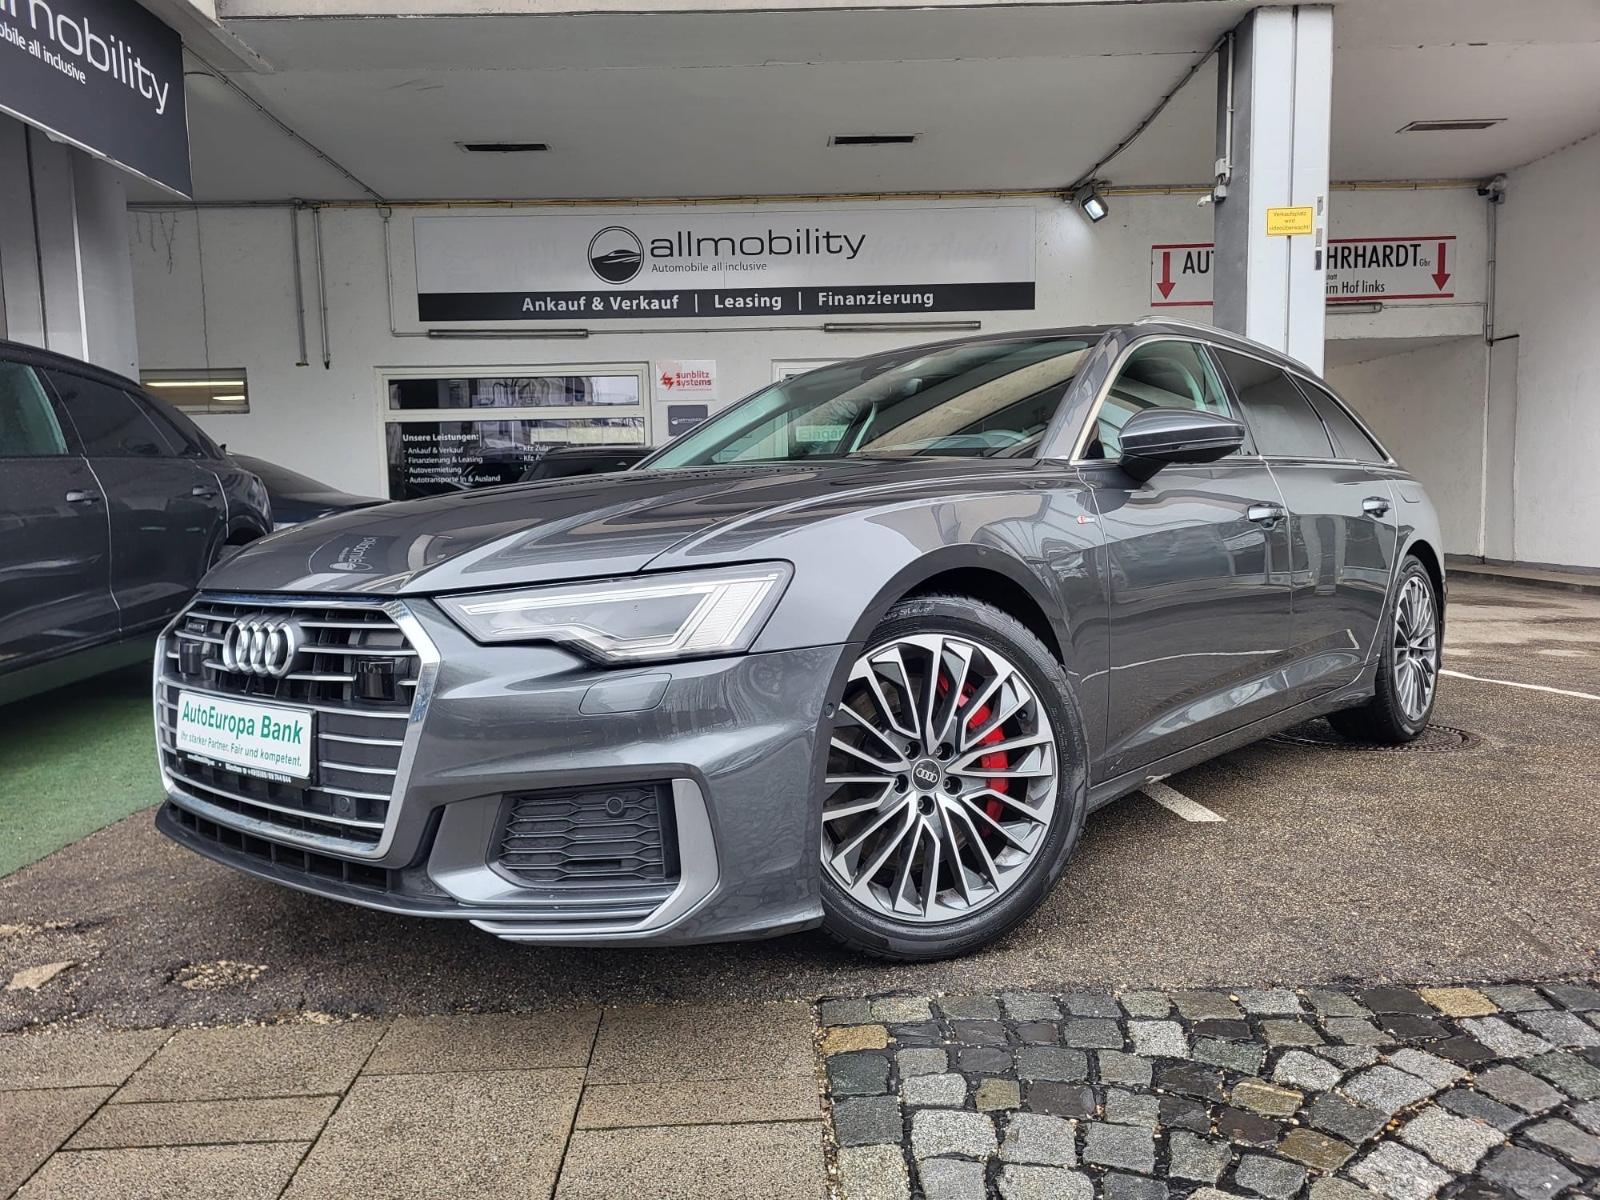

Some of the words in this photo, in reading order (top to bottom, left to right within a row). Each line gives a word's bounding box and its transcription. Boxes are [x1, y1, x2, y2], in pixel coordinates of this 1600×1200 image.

[0, 0, 169, 115] mobility
[28, 40, 41, 59] all
[43, 45, 86, 85] inclusive
[650, 228, 866, 260] allmobility
[651, 262, 709, 273] Automobile
[711, 261, 723, 272] all
[725, 261, 767, 272] inclusive
[1341, 280, 1360, 294] Hof
[1362, 279, 1385, 293] links
[522, 296, 586, 312] Ankauf
[592, 296, 604, 311] &
[610, 294, 679, 311] Verkauf
[714, 294, 782, 311] Leasing
[818, 290, 934, 308] Finanzierung
[676, 370, 710, 379] sunblitz
[676, 379, 712, 388] systems
[402, 434, 431, 442] Unsere
[432, 433, 479, 442] Leistungen:
[439, 446, 464, 454] Verkauf
[458, 456, 483, 464] Leasing
[182, 701, 255, 740] AutoEuropa
[260, 715, 303, 745] Bank
[230, 743, 243, 755] Fair
[244, 746, 258, 758] und
[260, 749, 302, 767] kompetent.
